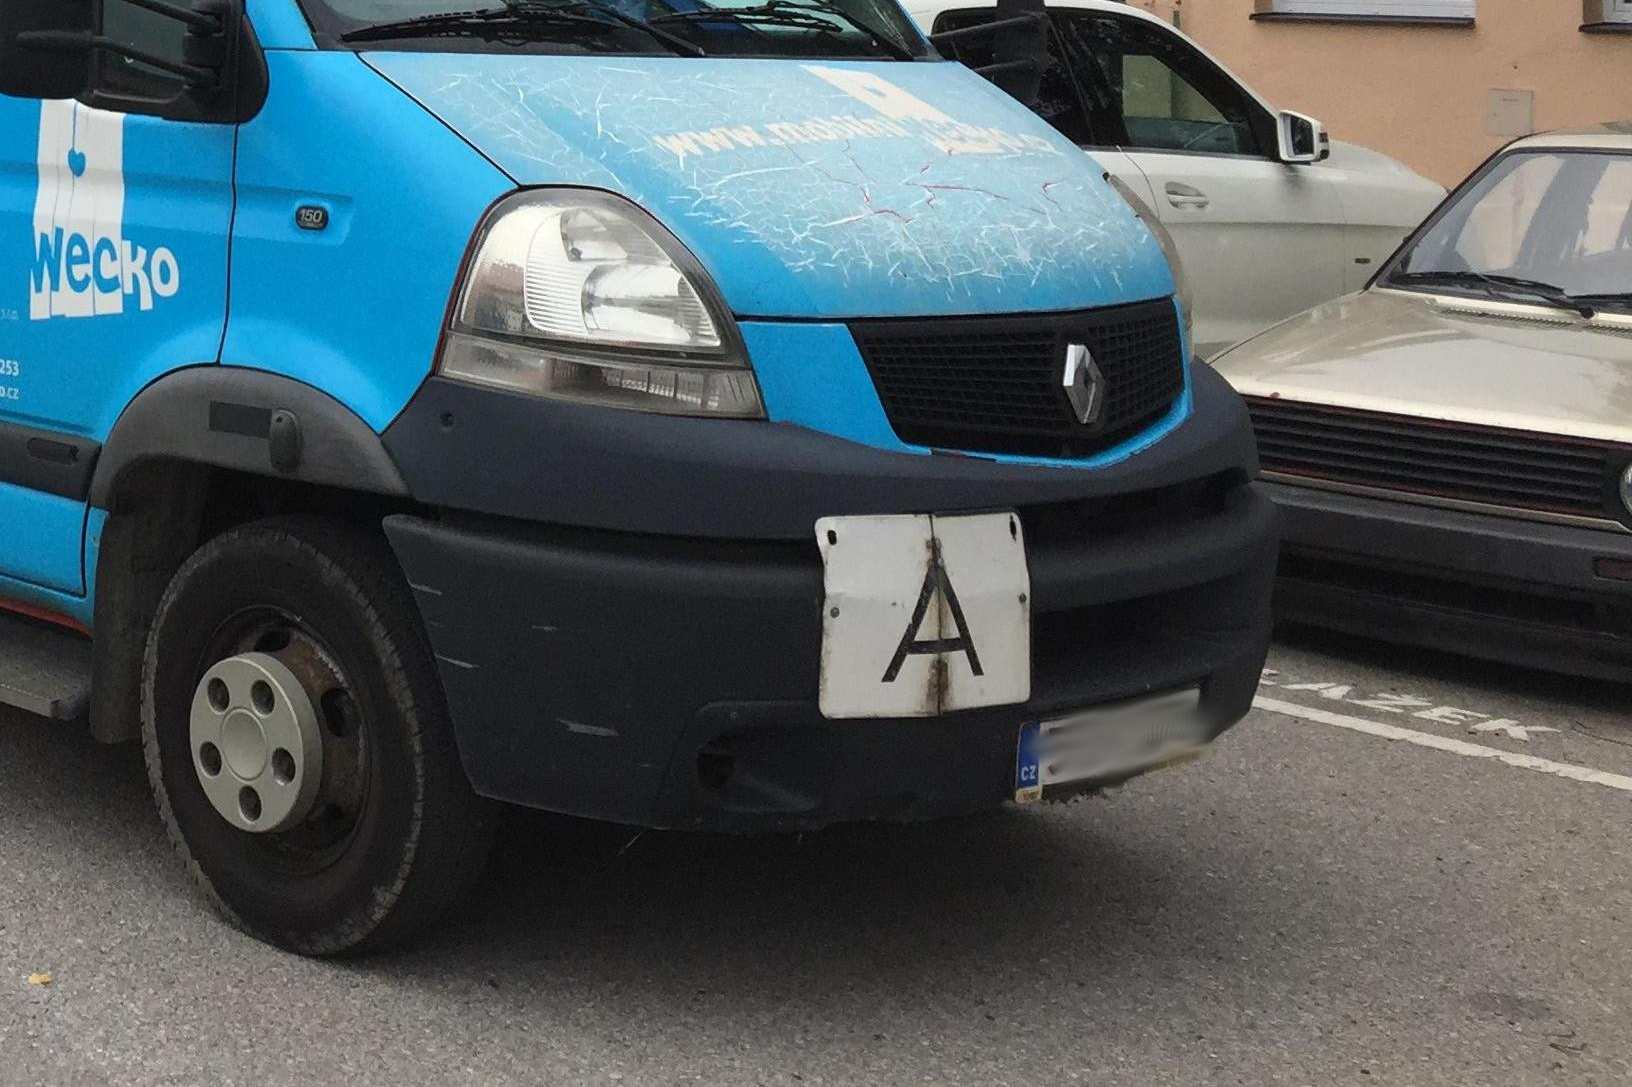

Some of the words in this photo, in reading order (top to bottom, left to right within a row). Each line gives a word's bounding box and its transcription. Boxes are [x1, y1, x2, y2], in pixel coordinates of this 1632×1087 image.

[299, 208, 324, 223] 150
[881, 563, 985, 683] A
[1021, 764, 1037, 782] CZ
